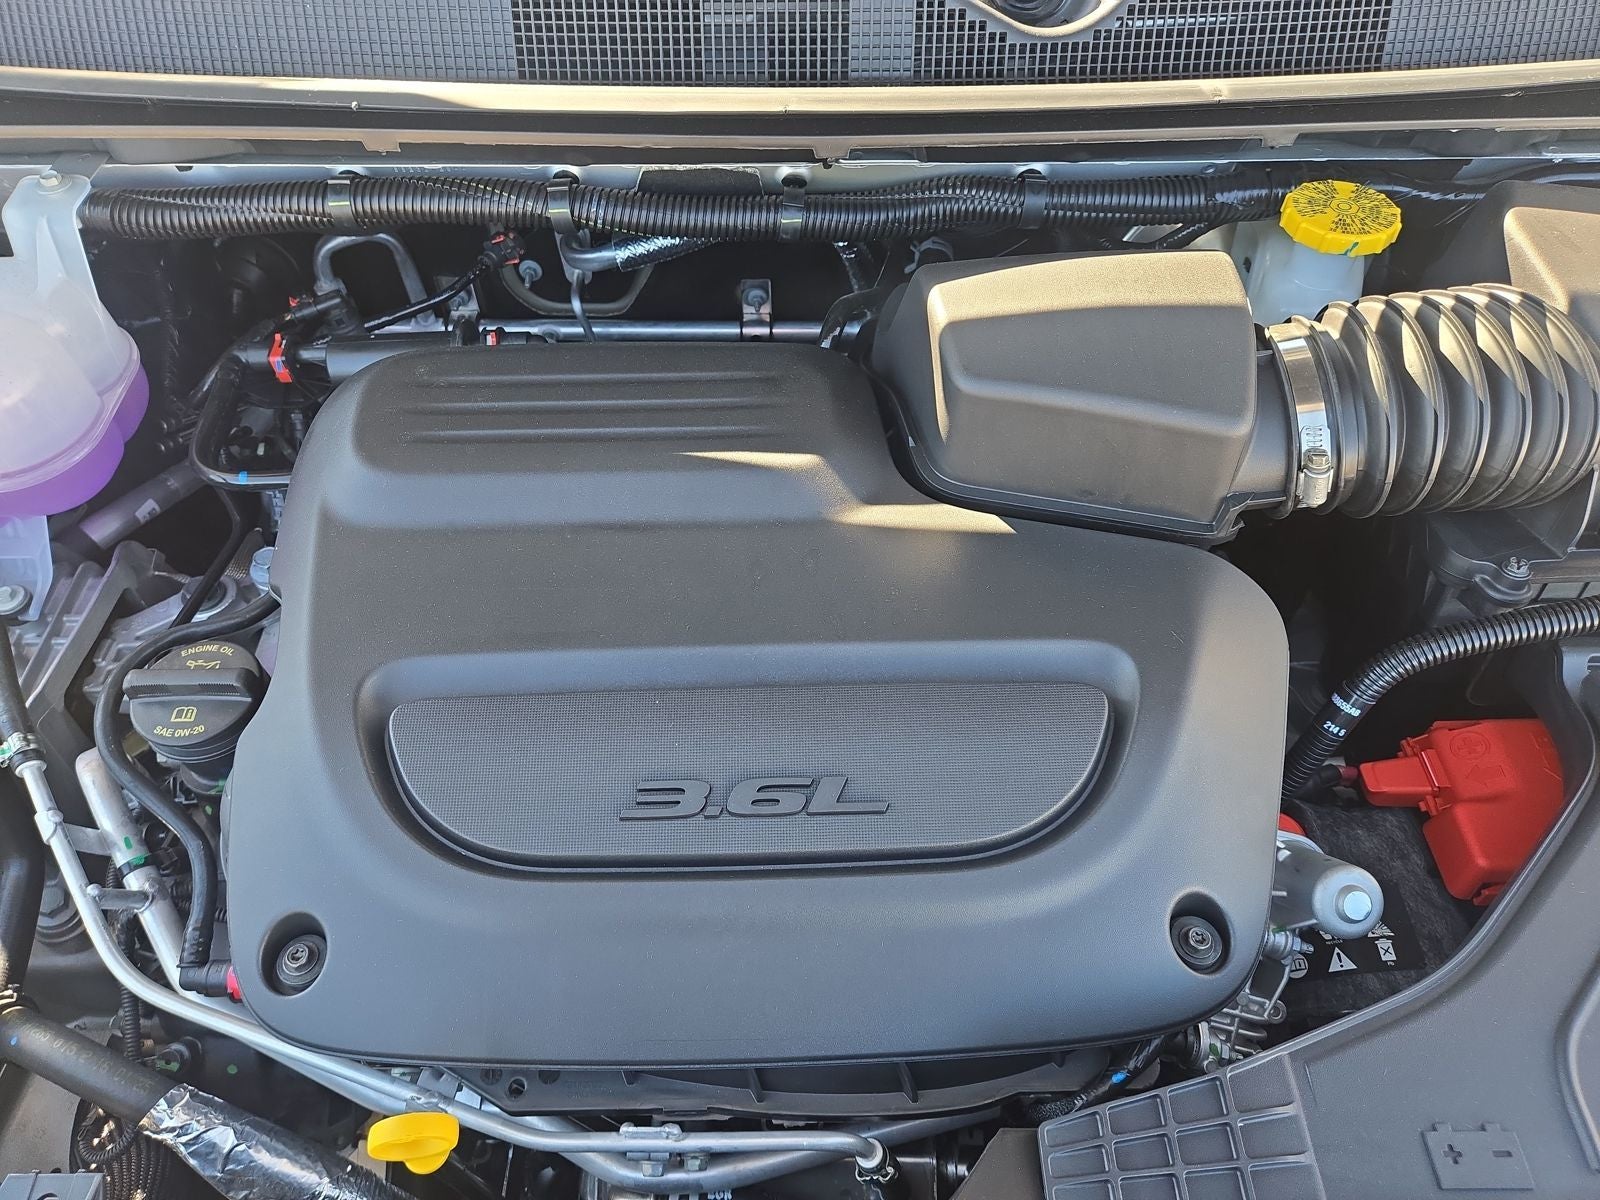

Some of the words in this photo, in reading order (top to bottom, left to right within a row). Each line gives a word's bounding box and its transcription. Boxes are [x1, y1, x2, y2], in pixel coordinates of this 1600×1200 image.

[181, 645, 219, 657] ENGINE
[220, 646, 235, 656] OIL
[154, 726, 174, 737] SAE
[174, 725, 205, 737] 0W-20
[619, 776, 890, 821] 3.6L
